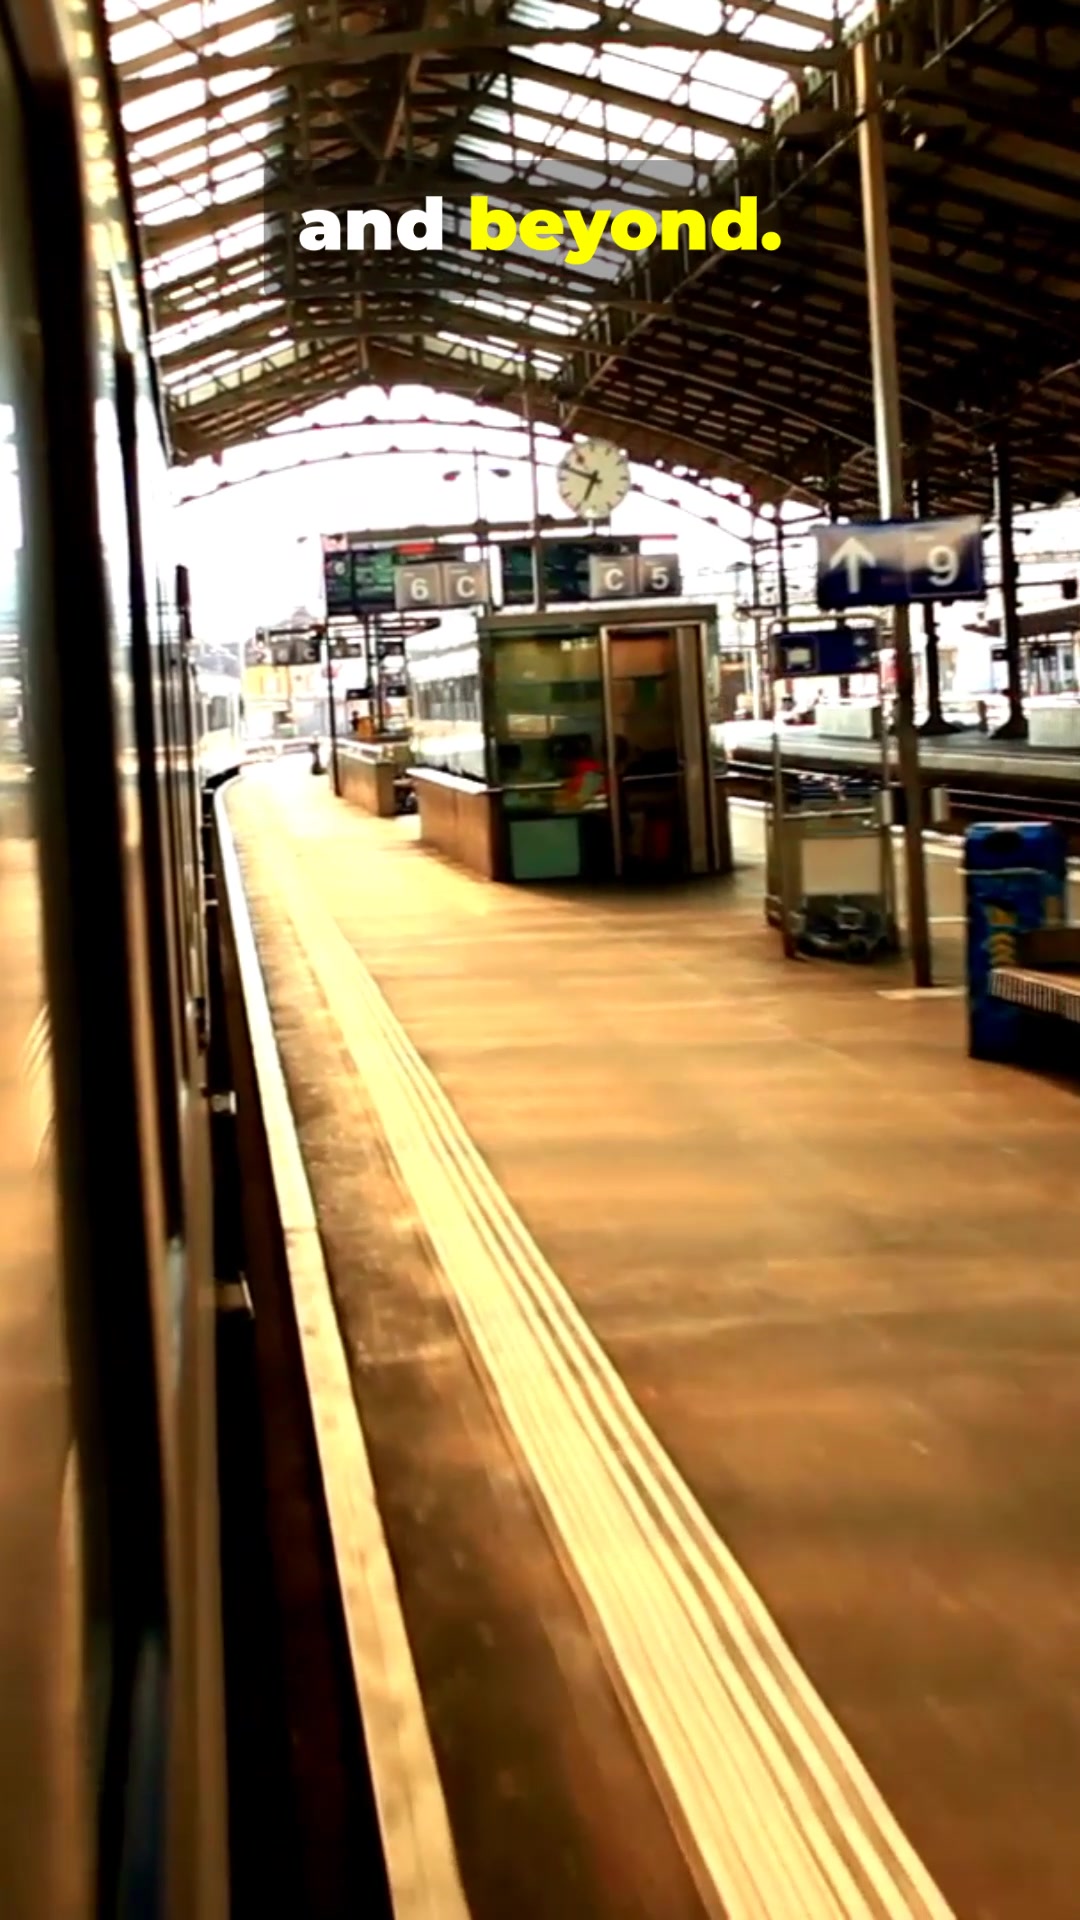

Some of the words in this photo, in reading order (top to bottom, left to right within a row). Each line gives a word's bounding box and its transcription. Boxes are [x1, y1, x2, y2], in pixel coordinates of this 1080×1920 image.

[928, 546, 959, 586] 9
[411, 577, 429, 601] 6
[456, 576, 475, 598] C
[604, 568, 624, 591] C
[651, 567, 669, 590] 5
